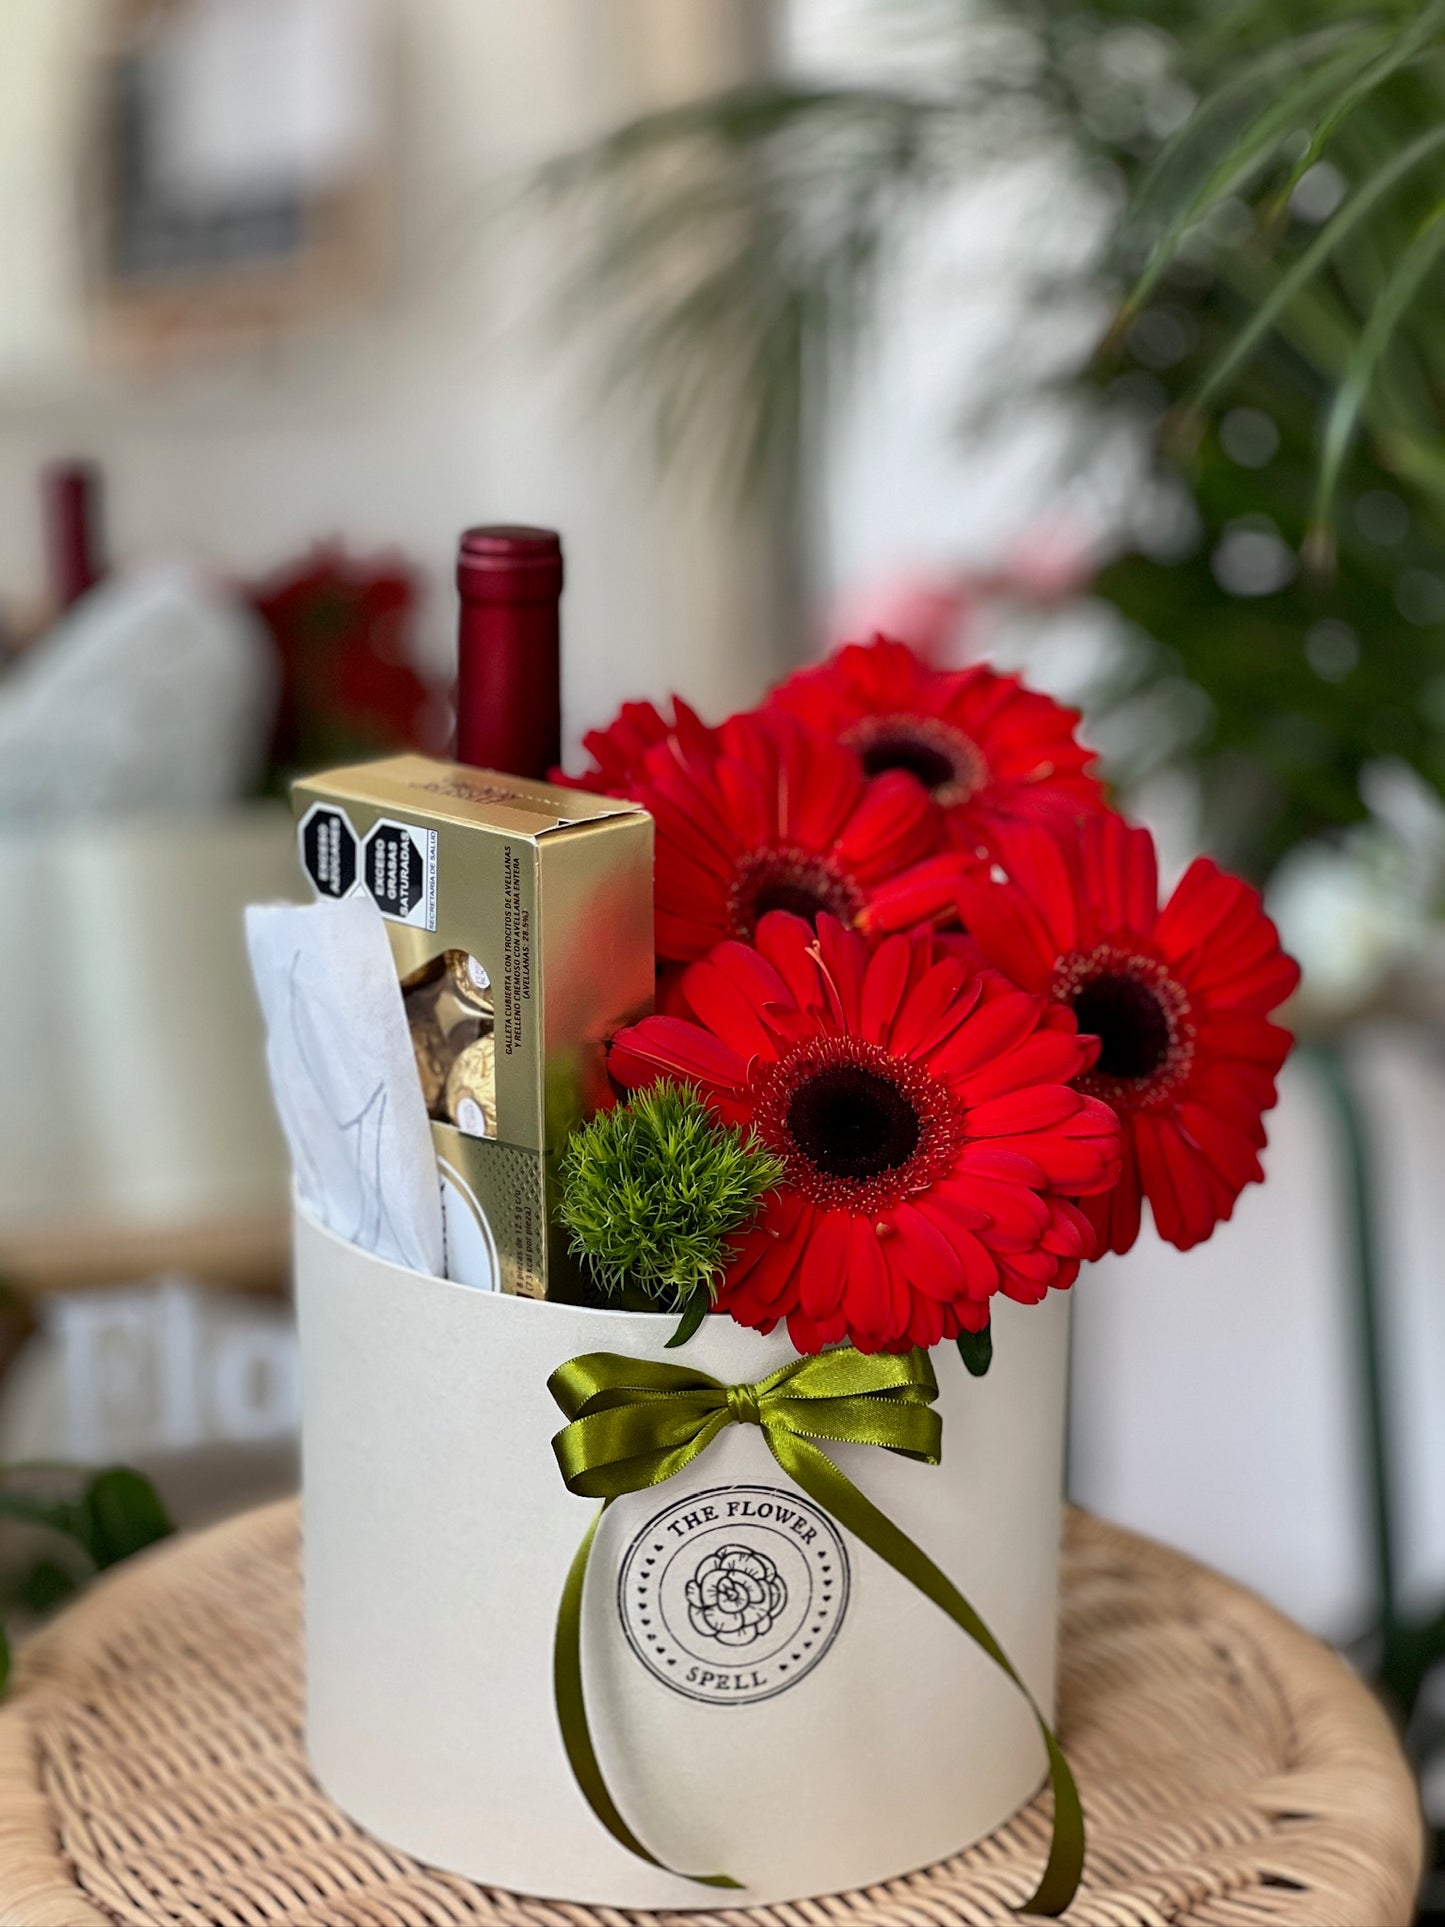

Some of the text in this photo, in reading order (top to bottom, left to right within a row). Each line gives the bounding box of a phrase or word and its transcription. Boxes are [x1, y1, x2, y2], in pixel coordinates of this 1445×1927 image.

[375, 838, 385, 896] EXCESO
[387, 841, 398, 900] GRASAS
[400, 830, 409, 918] SATURADAS
[430, 863, 436, 875] DE
[429, 876, 437, 930] SECRETARÍA
[505, 897, 512, 910] DE
[505, 1019, 513, 1055] GALLETA
[514, 1003, 522, 1042] RELLENO
[514, 1189, 522, 1205] c/u
[524, 1206, 533, 1236] pieza)
[515, 1237, 523, 1248] de
[525, 1237, 533, 1253] por
[525, 1254, 533, 1274] kcal
[667, 1501, 818, 1546] THE FLOWER
[686, 1666, 768, 1691] SPELL
